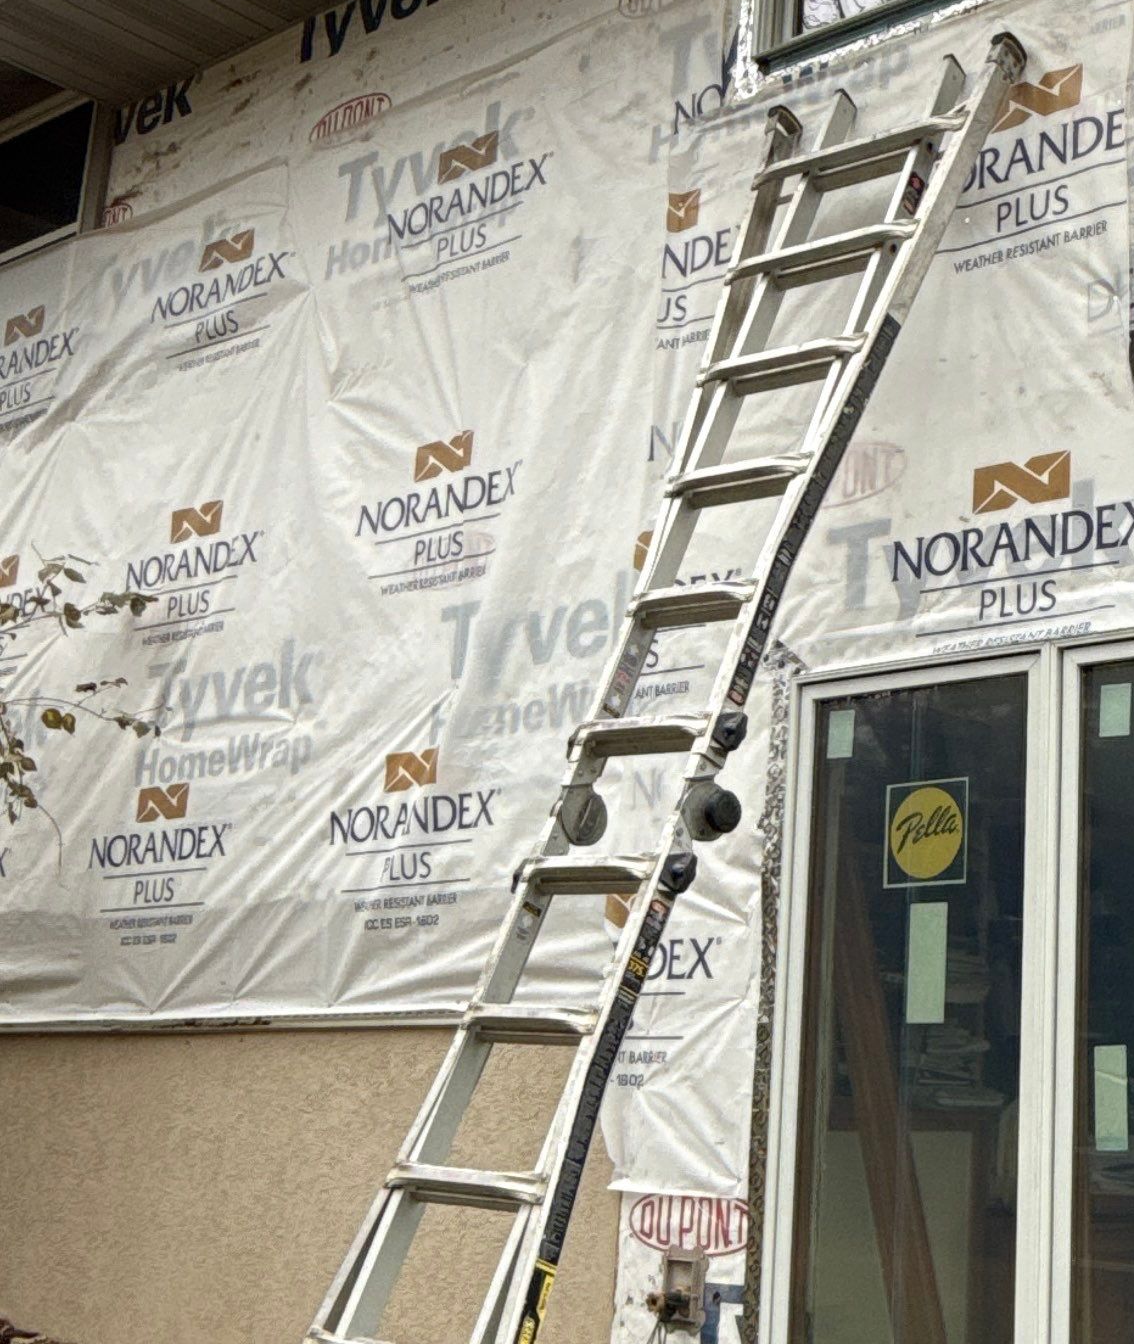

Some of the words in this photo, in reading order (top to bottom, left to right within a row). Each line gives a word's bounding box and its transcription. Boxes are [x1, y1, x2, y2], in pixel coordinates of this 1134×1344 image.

[387, 154, 548, 245] NORANDEX
[997, 185, 1070, 233] PLUS
[437, 223, 487, 261] PLUS
[954, 251, 1003, 275] WEATHER
[1005, 233, 1062, 262] RESISTANT
[1064, 219, 1108, 245] BARRIER
[151, 251, 289, 324] NORANDEX
[195, 309, 239, 343] PLUS
[355, 461, 519, 538] NORANDEX
[126, 531, 259, 592] NORANDEX
[414, 530, 464, 566] PLUS
[167, 589, 211, 620] PLUS
[978, 579, 1057, 621] PLUS
[329, 789, 497, 846] NORANDEX
[896, 805, 957, 855] Pella
[88, 825, 228, 870] NORANDEX
[133, 877, 175, 905] PLUS
